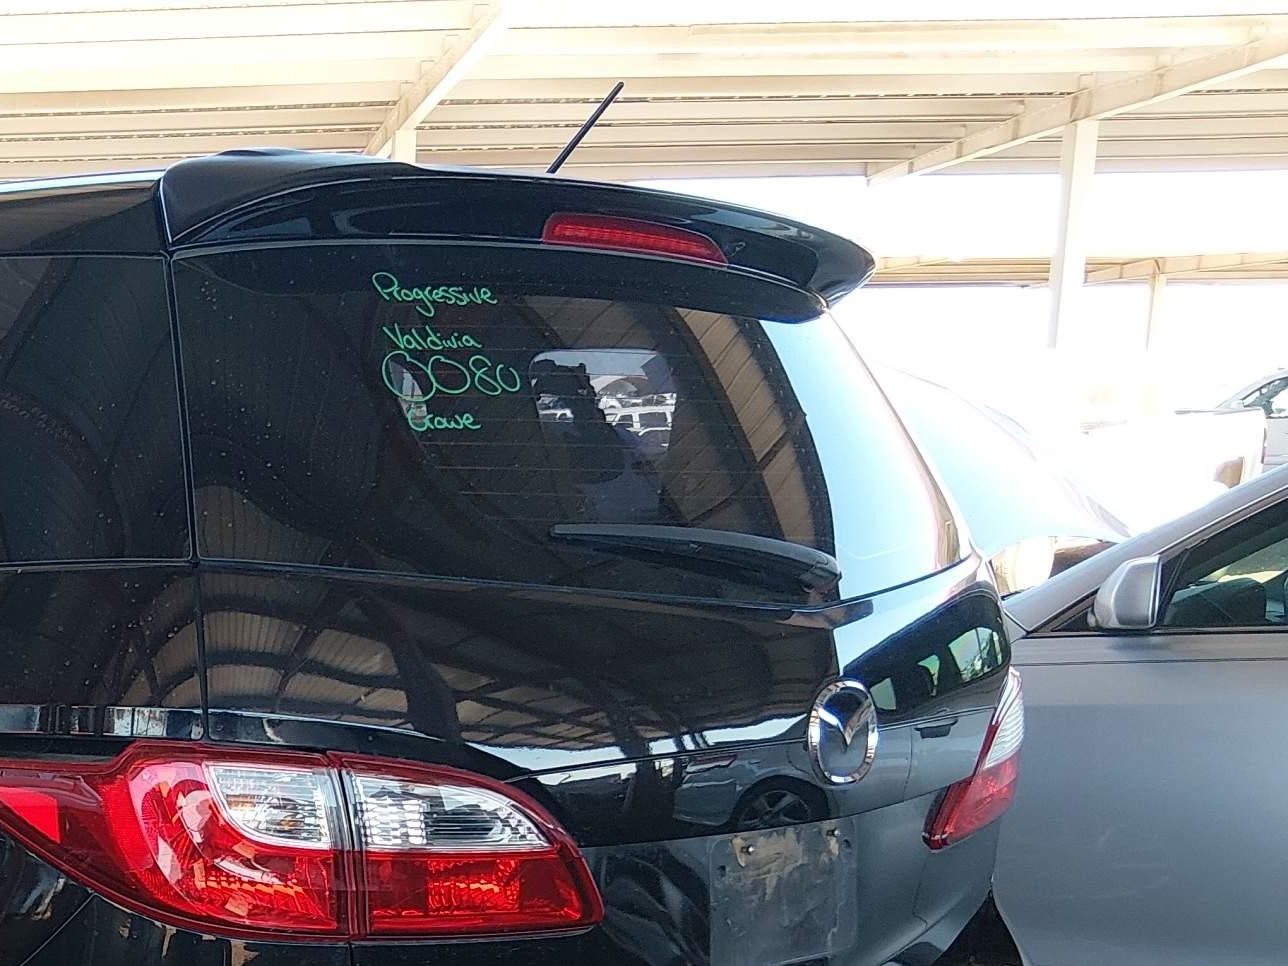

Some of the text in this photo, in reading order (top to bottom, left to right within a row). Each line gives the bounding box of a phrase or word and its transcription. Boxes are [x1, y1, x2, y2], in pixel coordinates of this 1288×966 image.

[372, 271, 498, 317] Progressive
[382, 322, 482, 350] Valdivia
[383, 351, 521, 402] 0080
